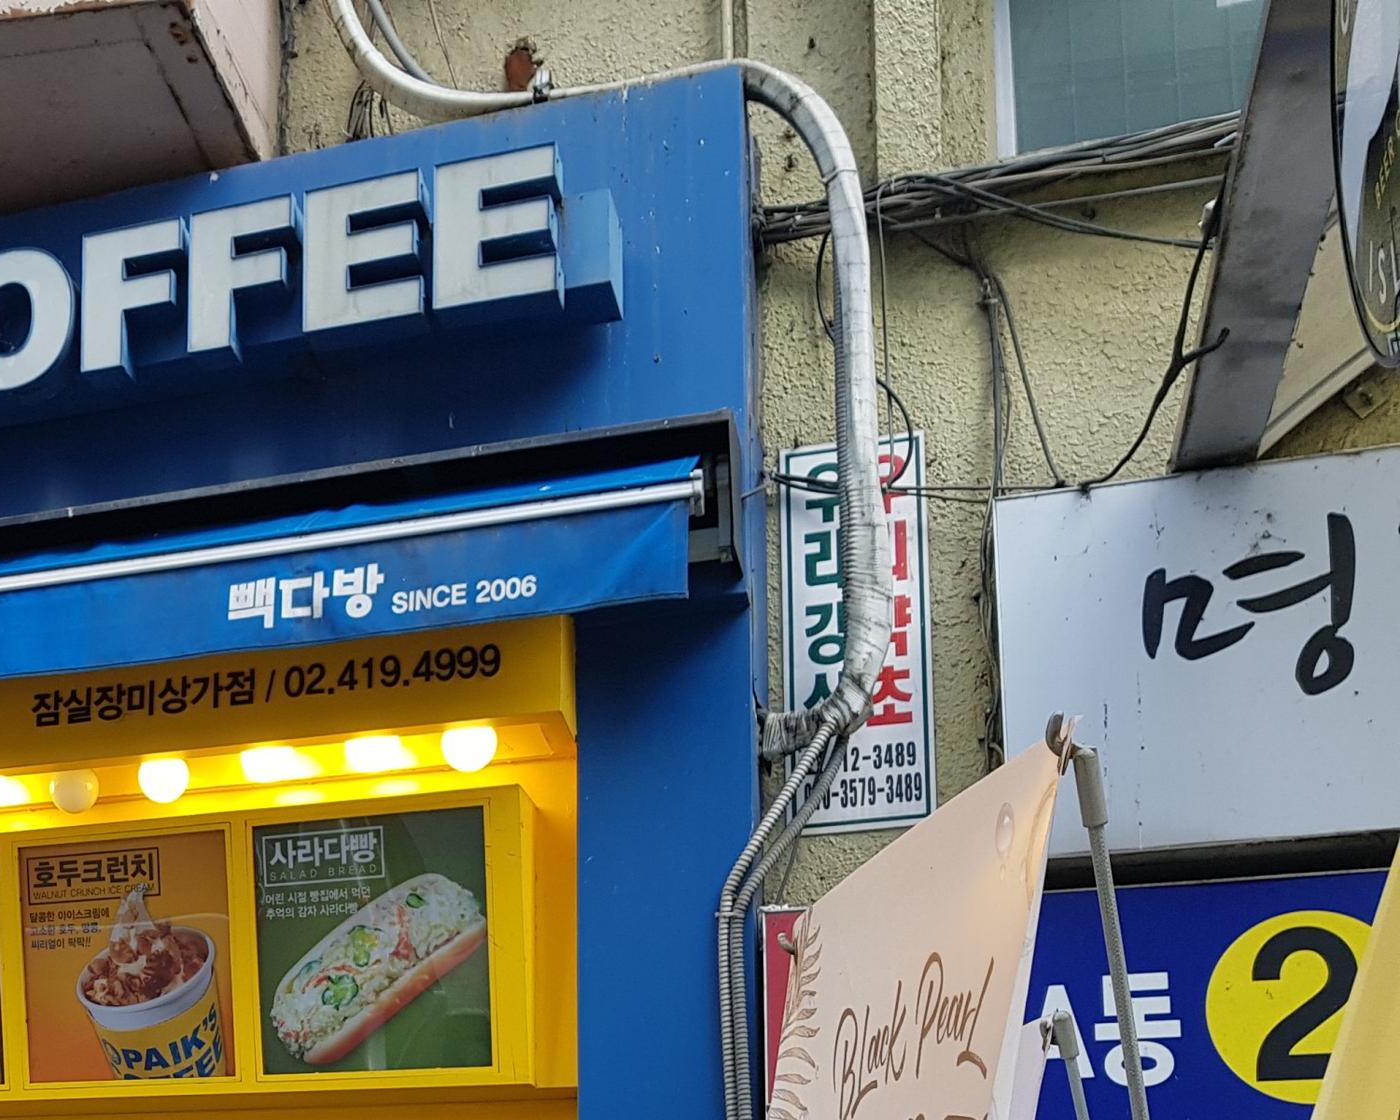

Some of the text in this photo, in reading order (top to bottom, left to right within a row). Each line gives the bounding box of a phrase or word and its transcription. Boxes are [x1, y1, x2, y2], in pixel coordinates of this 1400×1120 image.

[1374, 137, 1397, 210] BEER
[227, 562, 384, 628] 빽다방
[391, 574, 538, 615] SINCE 2006
[1143, 512, 1356, 696] 명
[31, 667, 257, 727] 잠실장미상가점
[283, 643, 502, 700] 02.419.4999
[840, 741, 918, 773] 12-3489
[803, 772, 923, 811] 00-3579-3489
[33, 851, 154, 889] 호두크런치
[269, 831, 377, 870] 사라다빵
[270, 863, 377, 882] SALAD BREAD
[33, 888, 67, 900] WALNUT
[70, 886, 106, 897] CRUNCH
[108, 885, 121, 895] ICE
[265, 893, 285, 906] 어린
[310, 887, 348, 902] 빵집에서
[57, 907, 110, 920] 아이스크림에
[915, 951, 995, 1079] Pearl
[121, 1002, 218, 1071] PAIK'S
